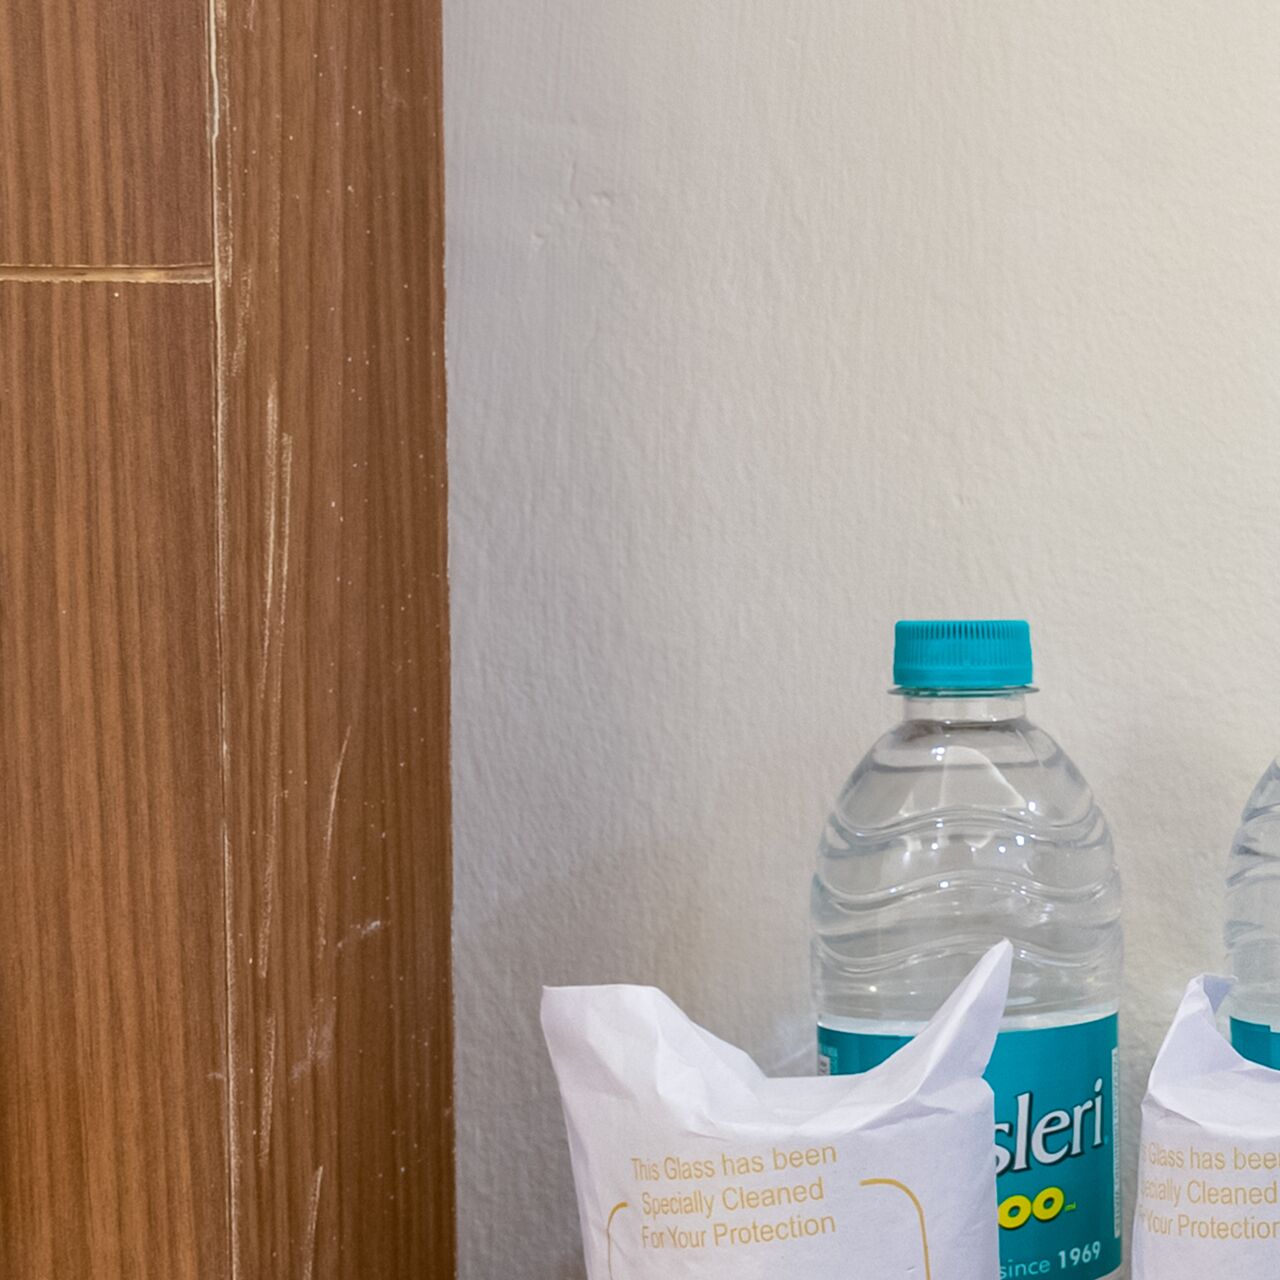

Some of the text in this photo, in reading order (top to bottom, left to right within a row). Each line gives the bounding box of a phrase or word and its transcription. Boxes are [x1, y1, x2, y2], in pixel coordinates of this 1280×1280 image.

[631, 1145, 837, 1181] This Glass has been
[1189, 1146, 1226, 1170] has
[641, 1176, 825, 1220] Specially Cleaned
[1187, 1180, 1278, 1206] Cleaned
[641, 1215, 836, 1249] For Your Protection
[1000, 1241, 1101, 1279] since 1969
